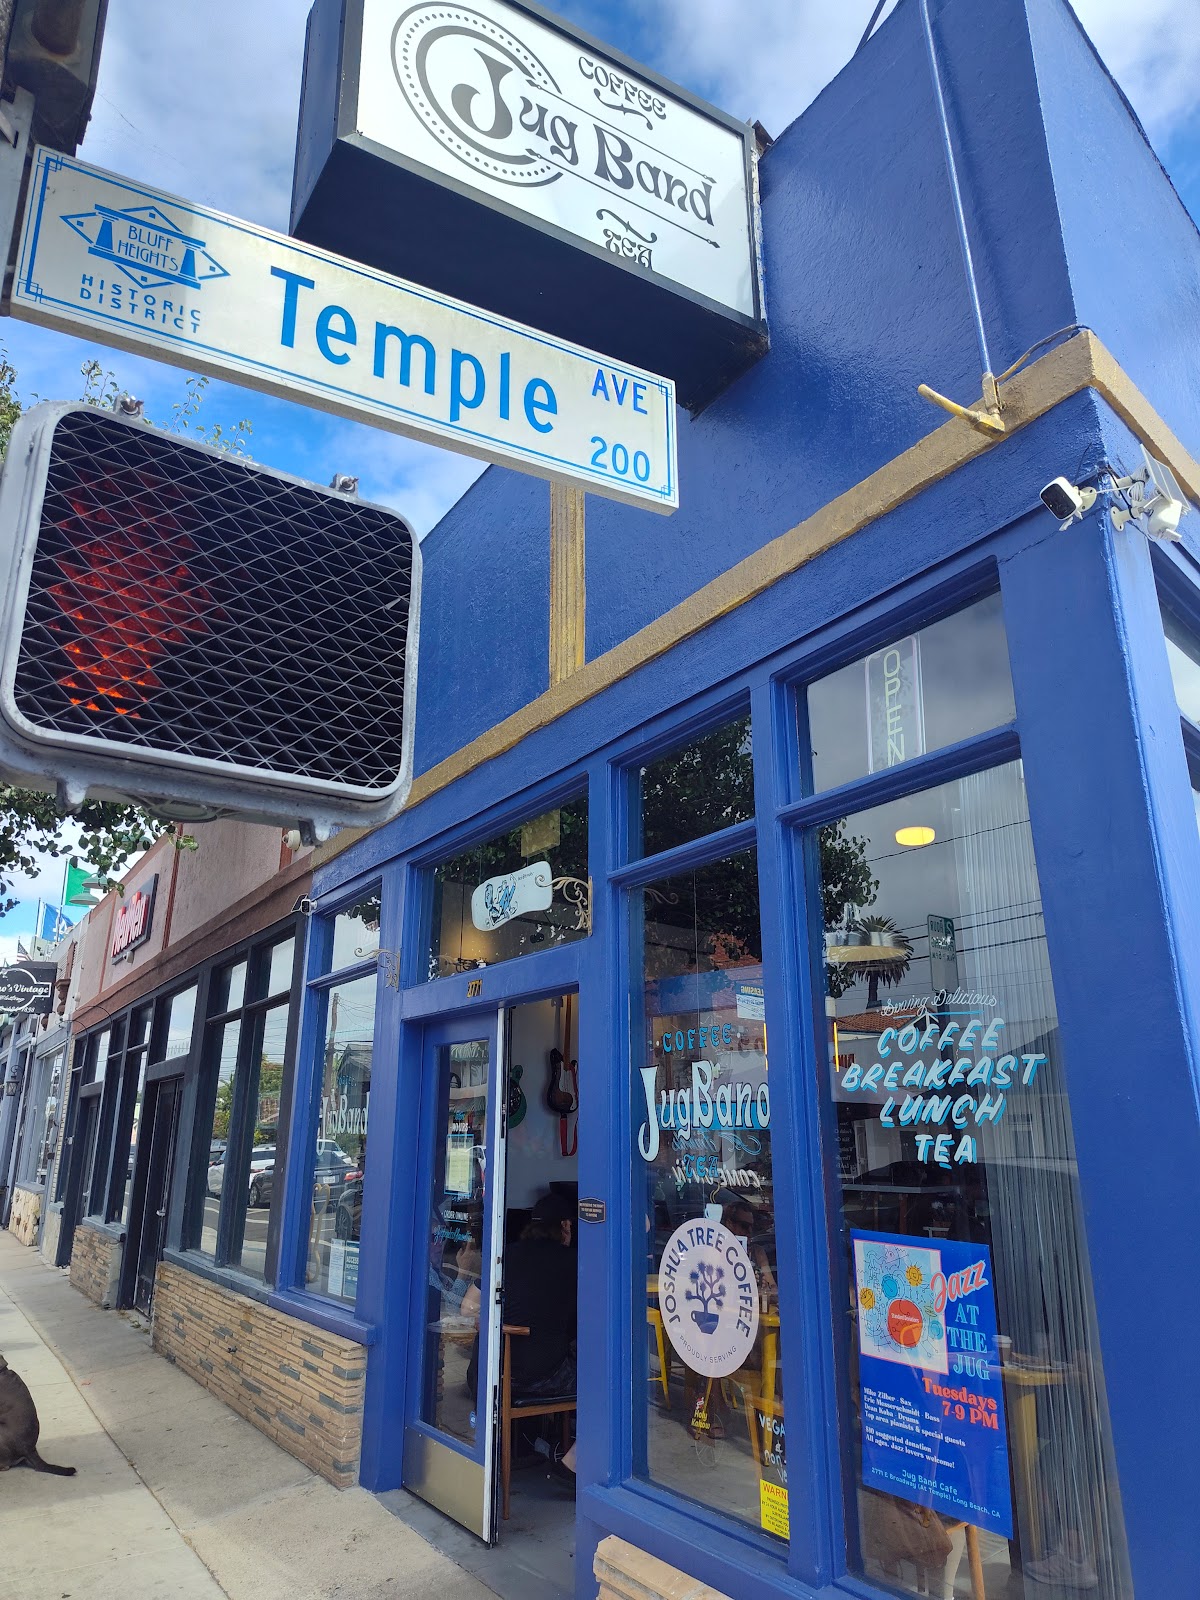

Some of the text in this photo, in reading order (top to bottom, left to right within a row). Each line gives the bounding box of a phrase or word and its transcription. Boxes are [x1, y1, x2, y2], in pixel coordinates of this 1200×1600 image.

[578, 56, 666, 121] COFFEE
[451, 47, 717, 227] Jug Band
[128, 225, 174, 251] BLUFF
[602, 228, 655, 270] TEA
[117, 240, 179, 272] HEIGHTS
[79, 287, 201, 333] DISTRICT
[81, 273, 201, 321] HISTORIC
[270, 266, 558, 434] Temple
[592, 369, 648, 415] AVE
[590, 436, 650, 482] 200
[883, 649, 906, 767] OPEN
[0, 984, 49, 995] o's Vintage
[467, 979, 482, 998] 2771
[881, 986, 997, 1016] Serving Delicious
[663, 1023, 732, 1053] COFFEE
[877, 1017, 1005, 1058] COFFEE
[841, 1053, 1048, 1093] BREAKFAST
[879, 1093, 1007, 1128] LUNCH
[683, 1153, 719, 1178] TEA
[914, 1133, 977, 1169] TEA
[664, 1226, 753, 1338] JOSHUA TREE COFFEE
[930, 1260, 989, 1313] Jazz
[955, 1303, 979, 1326] AT
[679, 1335, 737, 1364] PROUDLY SERVING
[947, 1327, 988, 1354] THE
[953, 1354, 990, 1380] JUG
[864, 1395, 875, 1404] Eric
[924, 1411, 940, 1423] Bass
[899, 1397, 912, 1406] Sax
[922, 1376, 997, 1411] Tuesdays
[694, 1410, 708, 1422] Holy
[865, 1410, 966, 1447] Top area pianists & special guests
[897, 1412, 920, 1425] Drums
[942, 1401, 999, 1430] 7-9 PM
[865, 1433, 874, 1442] All
[890, 1442, 904, 1452] Jazz
[905, 1446, 925, 1459] lovers
[925, 1454, 955, 1469] welcome!
[875, 1430, 903, 1444] suggested
[904, 1438, 932, 1453] donation
[890, 1473, 917, 1490] Broadway
[952, 1495, 968, 1508] Long
[991, 1509, 1001, 1518] CA
[901, 1469, 958, 1496] Jug Band Cafe
